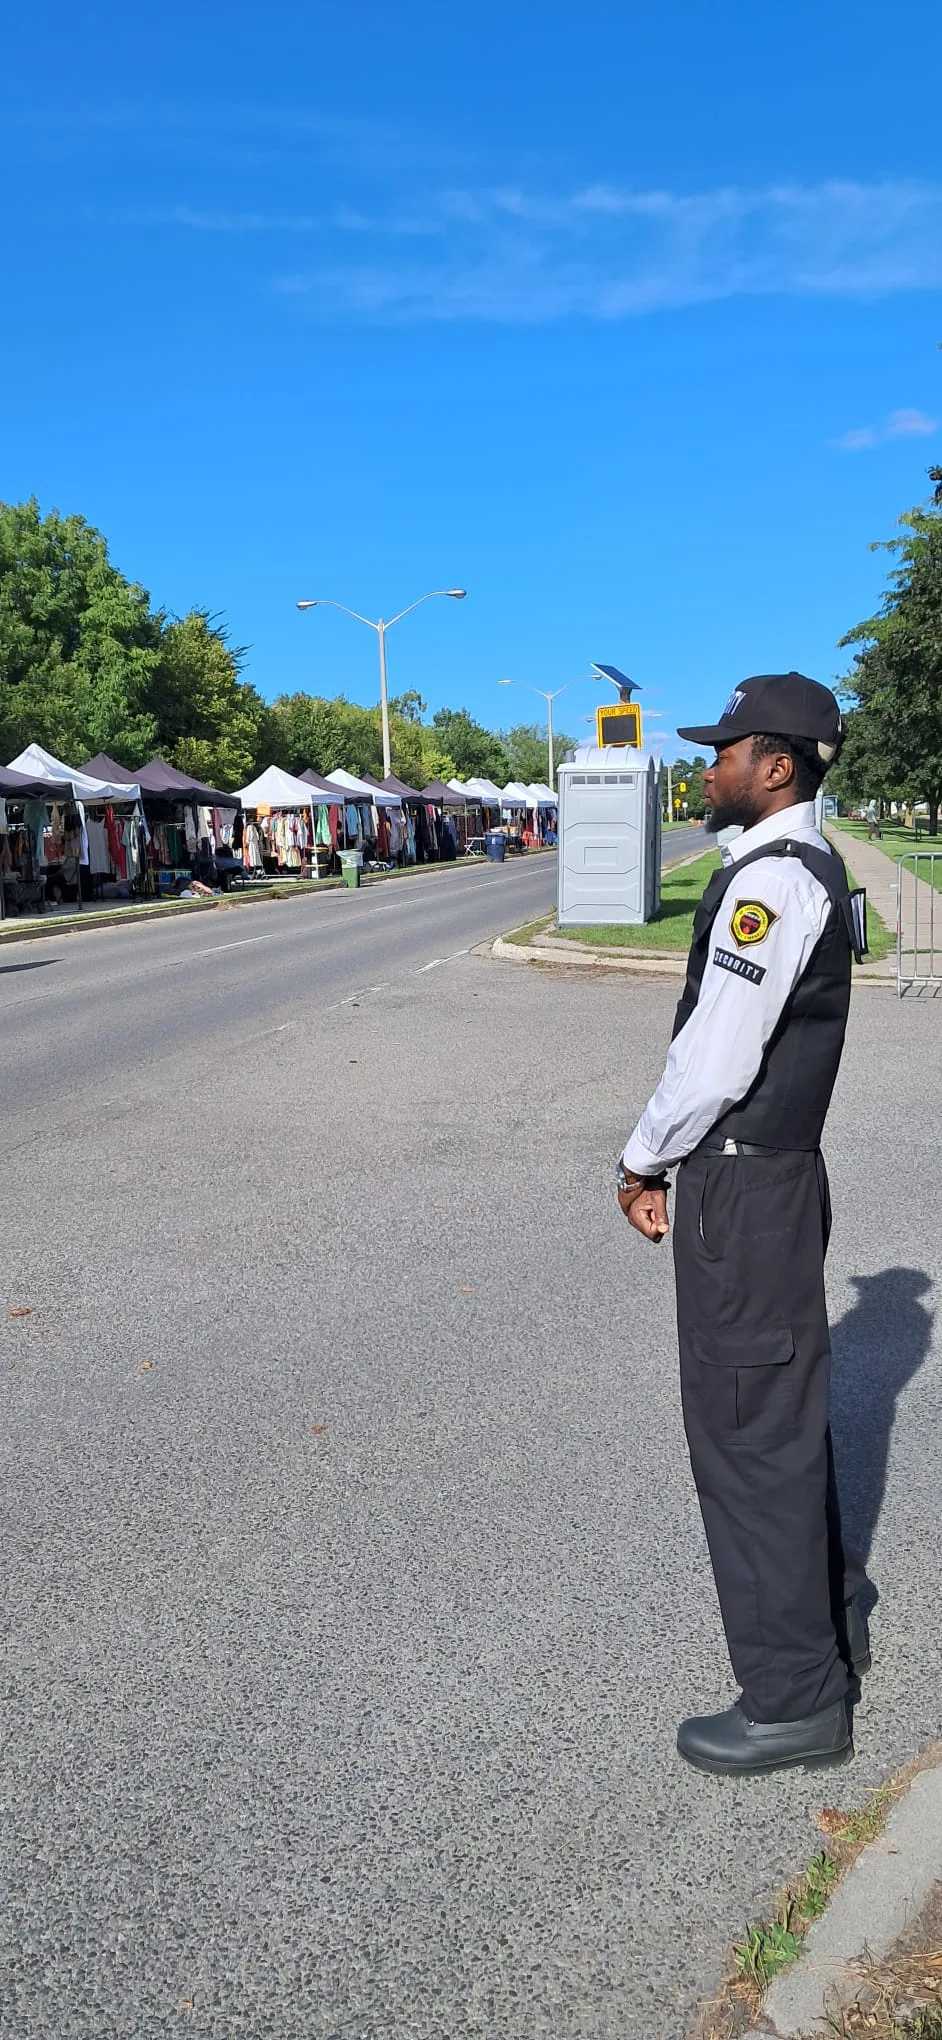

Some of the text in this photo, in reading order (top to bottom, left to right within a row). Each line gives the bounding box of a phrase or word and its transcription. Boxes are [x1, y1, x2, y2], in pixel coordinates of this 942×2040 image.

[600, 706, 637, 716] YOUR SPEED
[714, 951, 760, 979] SECURITY
